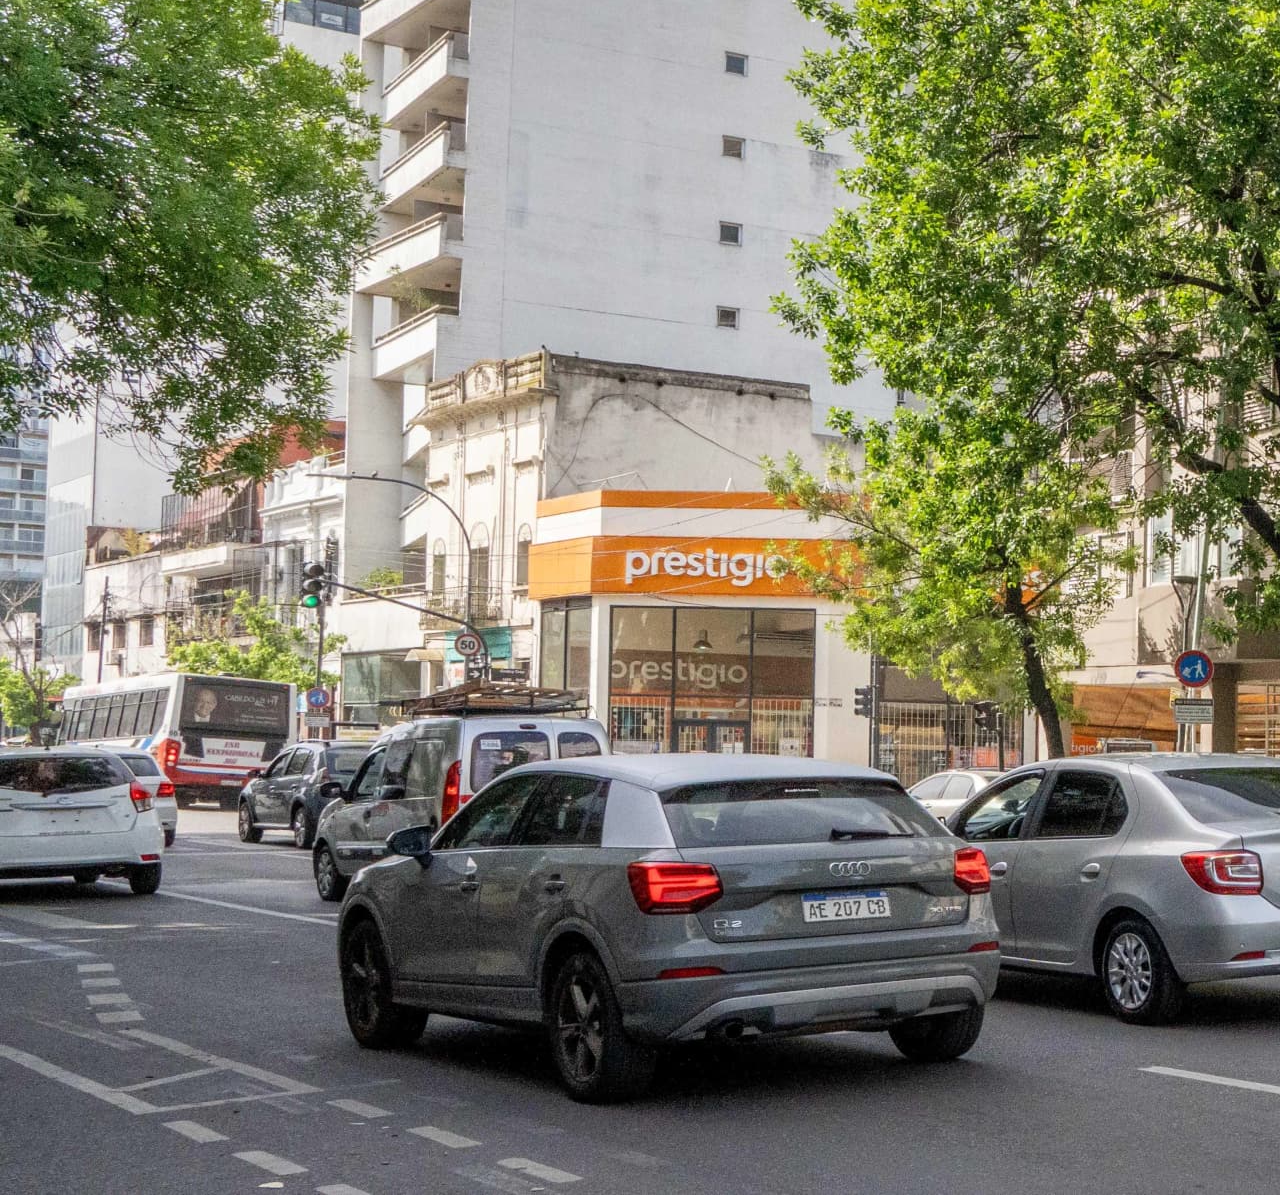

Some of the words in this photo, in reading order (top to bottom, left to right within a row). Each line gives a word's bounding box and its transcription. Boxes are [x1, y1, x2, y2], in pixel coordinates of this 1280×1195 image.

[625, 547, 788, 586] prestigio
[460, 639, 476, 651] 50
[611, 656, 748, 689] prestigio
[809, 903, 827, 919] AE
[833, 901, 861, 918] 207
[867, 898, 886, 916] CB
